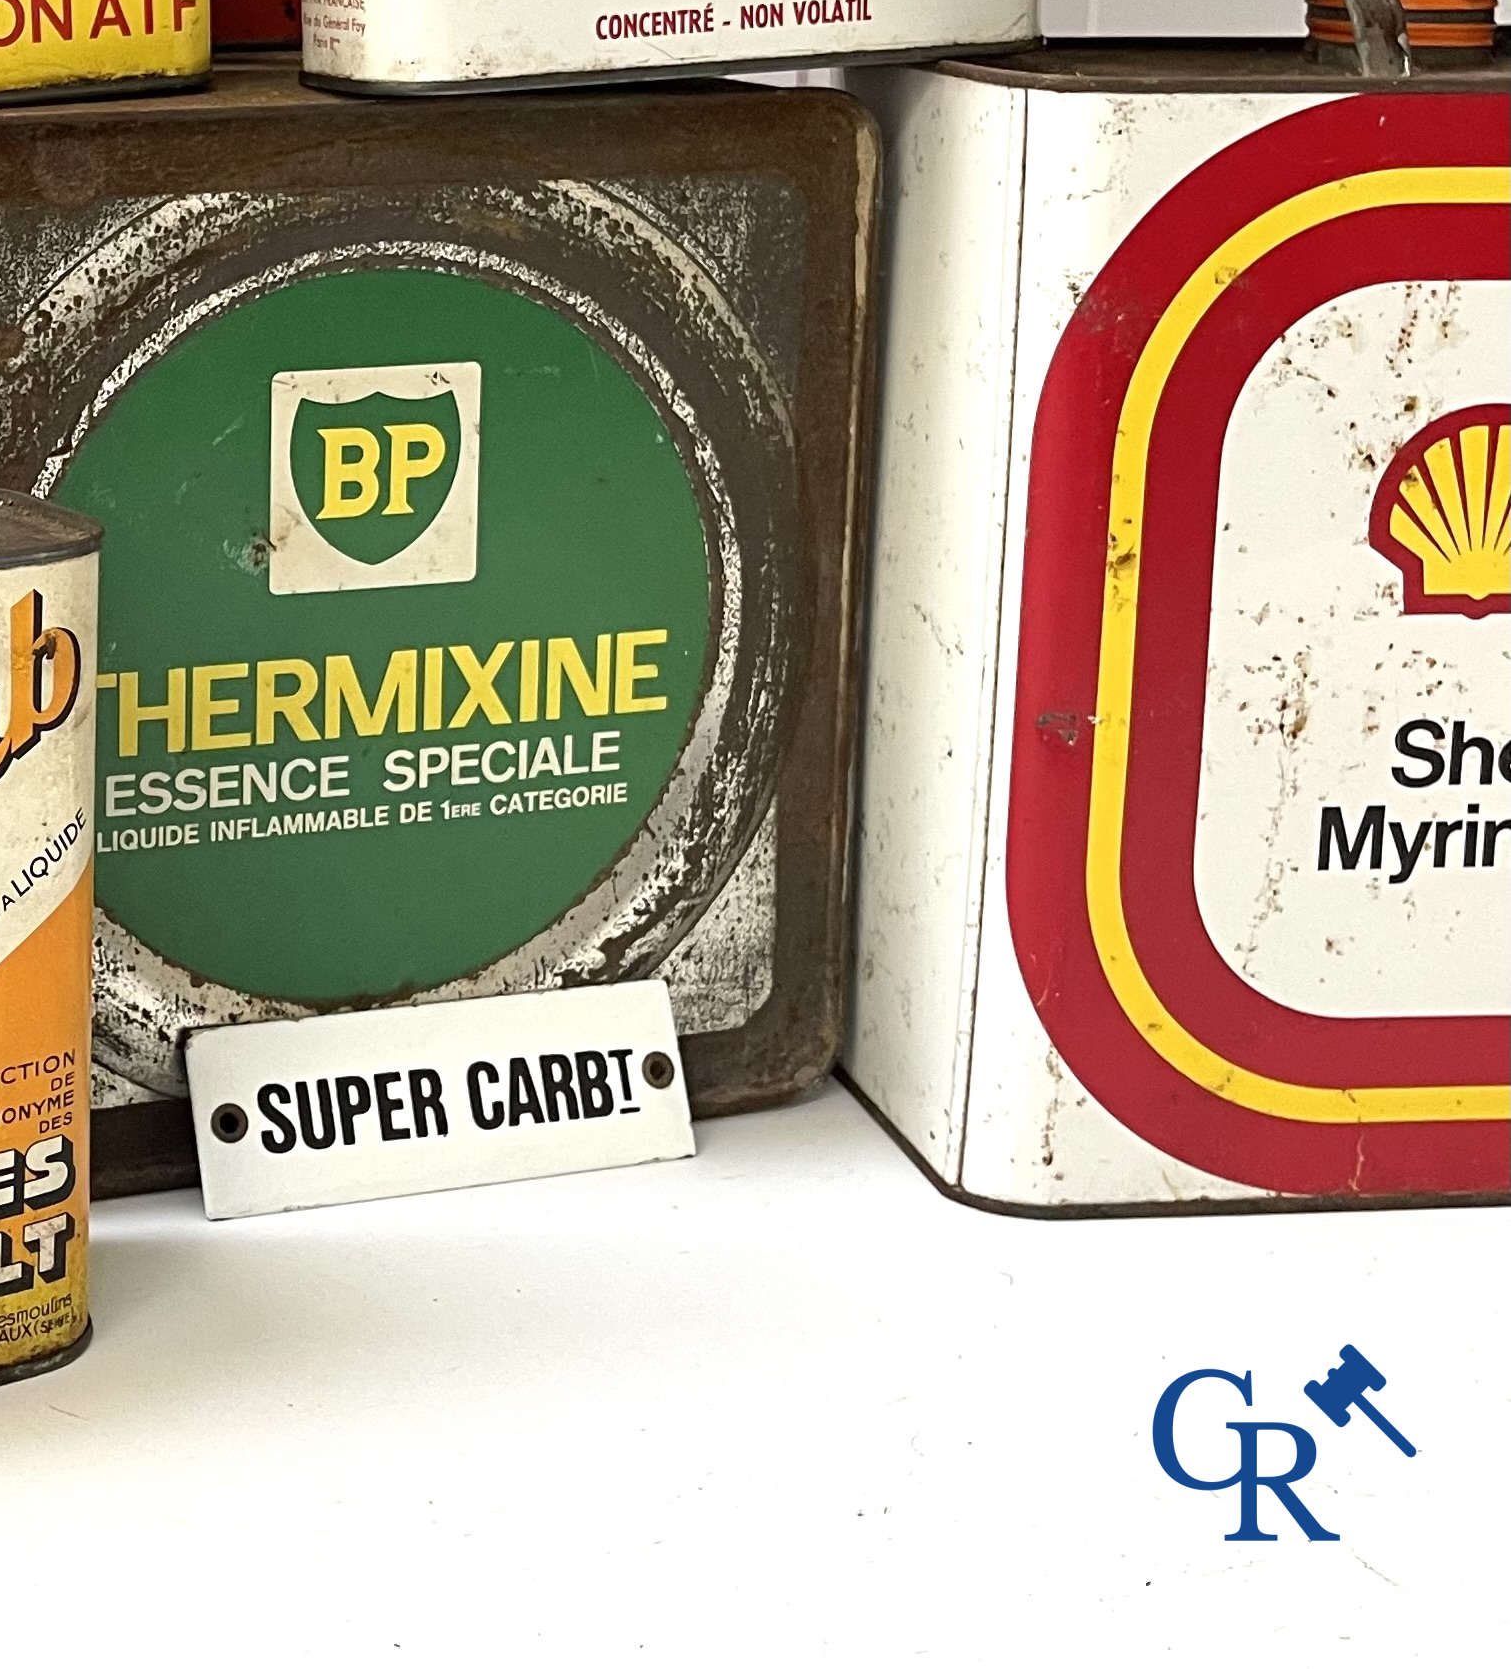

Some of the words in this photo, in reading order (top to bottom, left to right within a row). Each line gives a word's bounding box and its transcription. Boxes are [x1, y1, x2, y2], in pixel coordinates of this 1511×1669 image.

[595, 3, 714, 40] CONCENTRÉ
[740, 3, 783, 30] NON
[316, 423, 447, 520] BP
[105, 755, 350, 817] ESSENCE
[383, 731, 621, 793] SPECIALE
[11, 806, 88, 898] LIQUIDE
[96, 823, 200, 854] LIQUIDE
[211, 805, 389, 843] INFLAMMABLE
[400, 800, 433, 823] DE
[490, 783, 628, 816] CATEGORIE
[51, 1071, 75, 1091] DE
[257, 1068, 448, 1154] SUPER
[39, 1112, 73, 1134] DES
